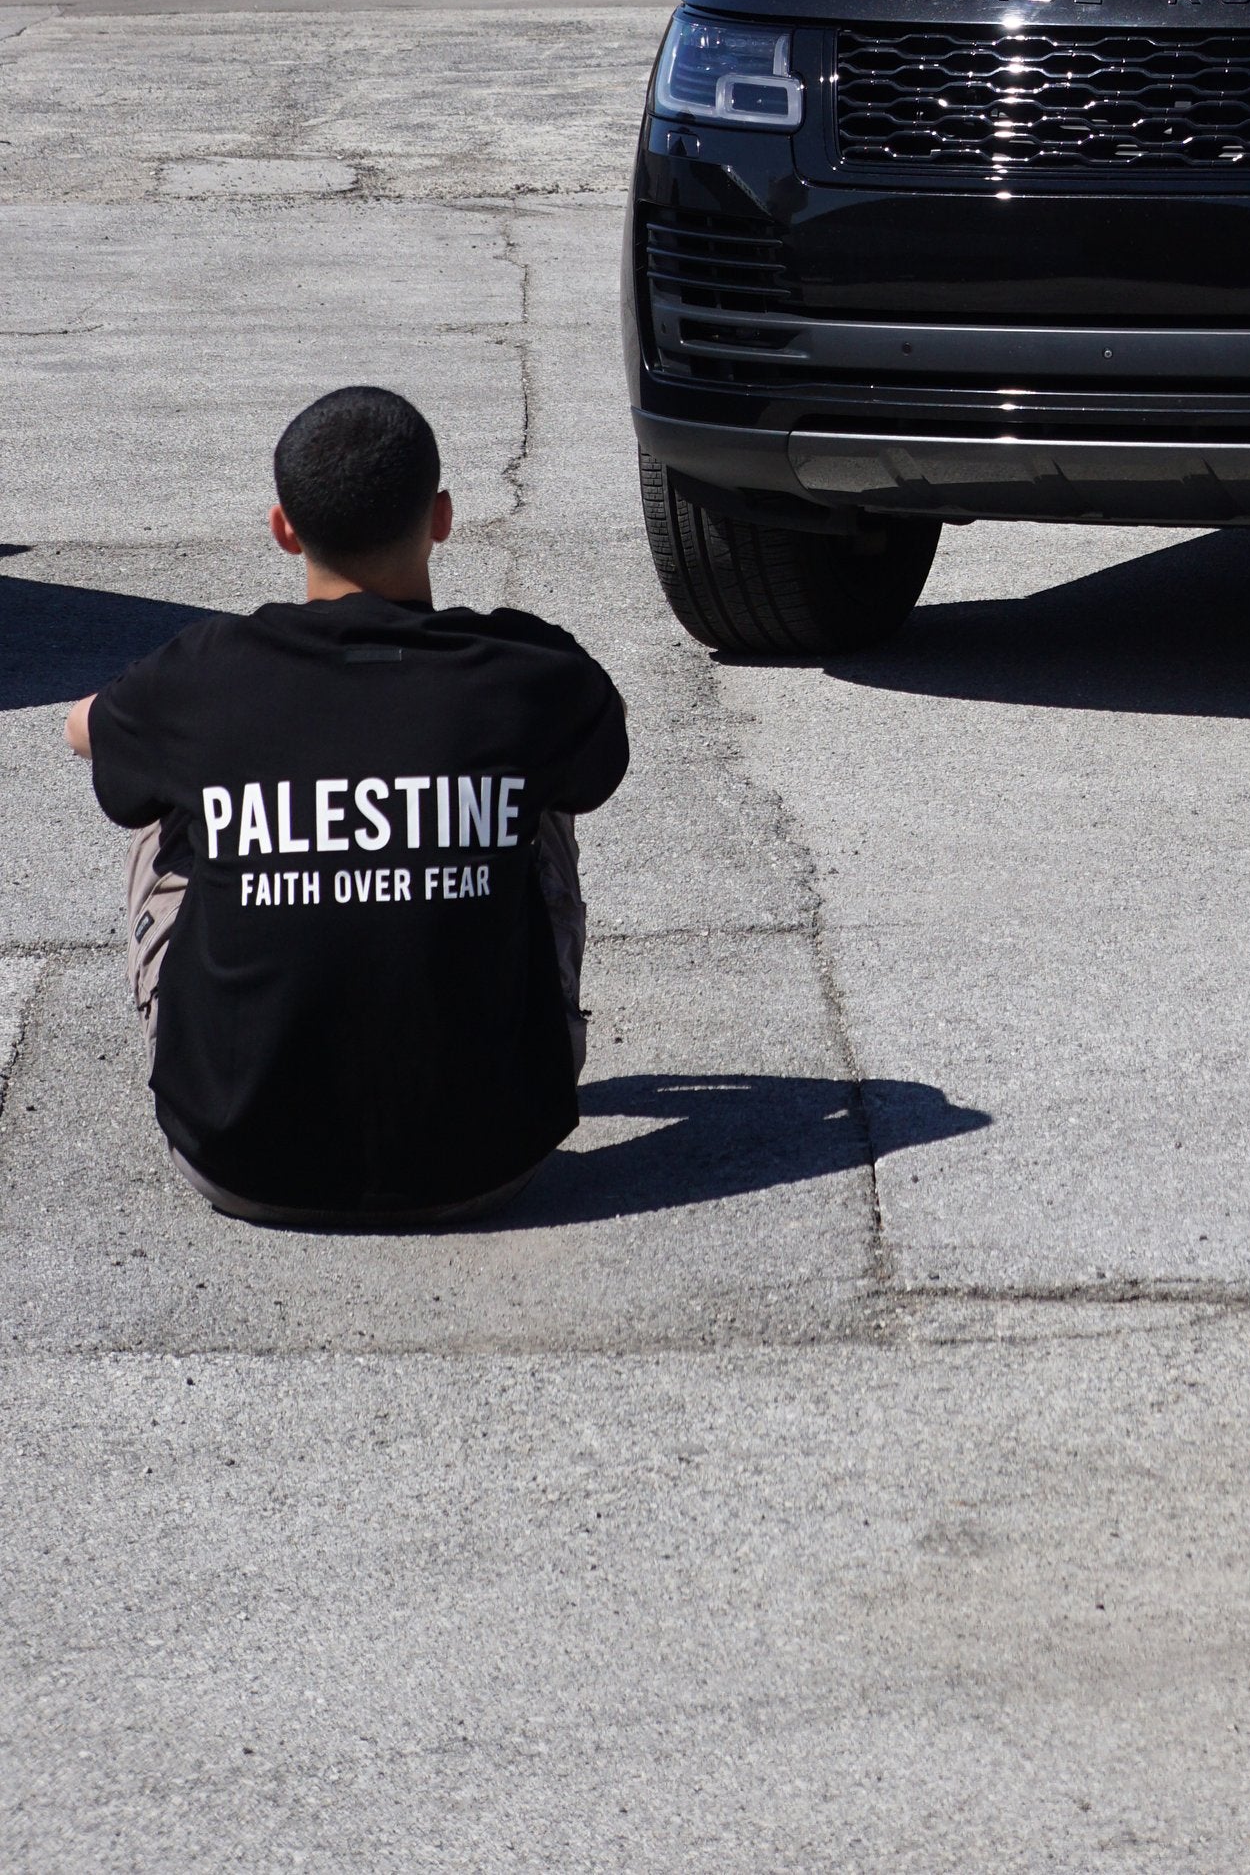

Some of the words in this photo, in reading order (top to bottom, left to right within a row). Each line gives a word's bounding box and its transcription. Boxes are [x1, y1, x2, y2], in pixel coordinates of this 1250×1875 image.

[202, 776, 525, 859] PALESTINE
[241, 871, 320, 906] FAITH
[334, 868, 412, 904] OVER
[424, 865, 491, 901] FEAR
